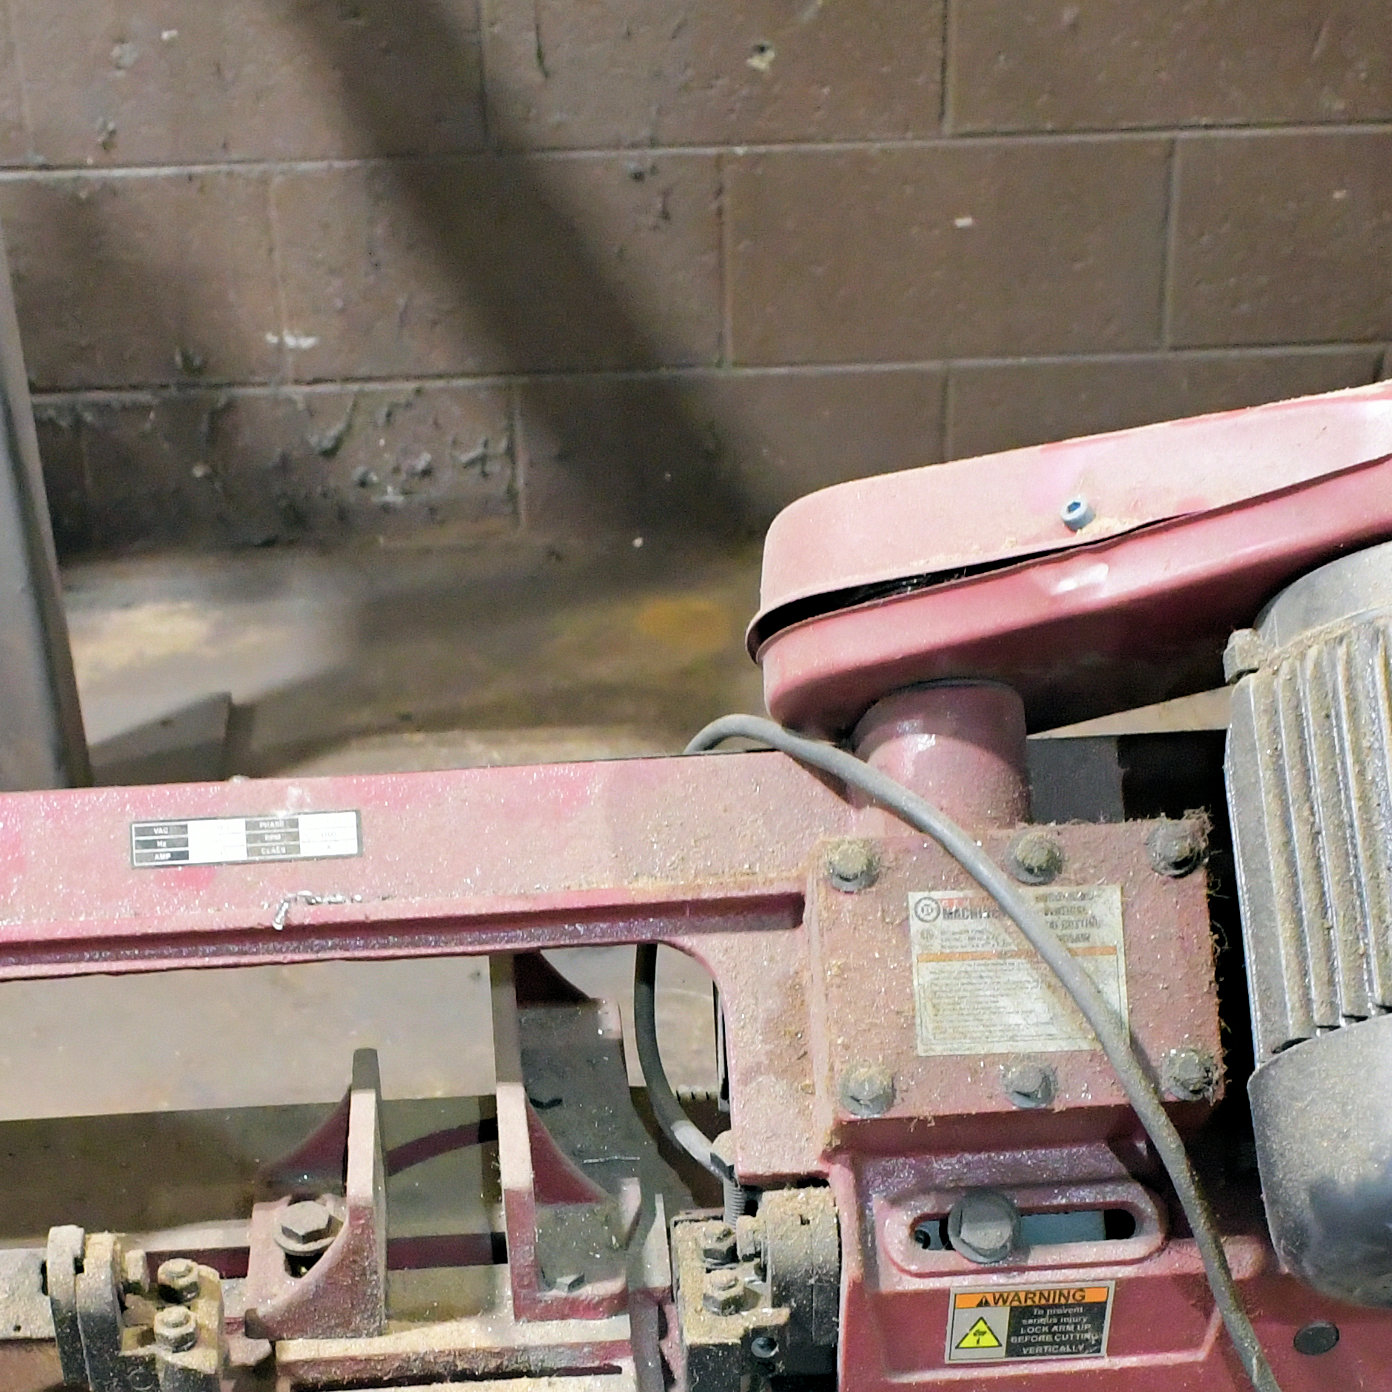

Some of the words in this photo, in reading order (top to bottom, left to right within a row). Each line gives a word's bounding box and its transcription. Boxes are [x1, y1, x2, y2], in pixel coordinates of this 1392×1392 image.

[992, 1288, 1086, 1306] WARNING
[1033, 1307, 1044, 1316] To
[1047, 1306, 1084, 1317] prevent
[1022, 1317, 1058, 1326] serious
[1020, 1325, 1049, 1334] LOCK
[1051, 1324, 1075, 1333] ARM
[1077, 1323, 1092, 1332] UP
[1010, 1334, 1052, 1343] BEFORE
